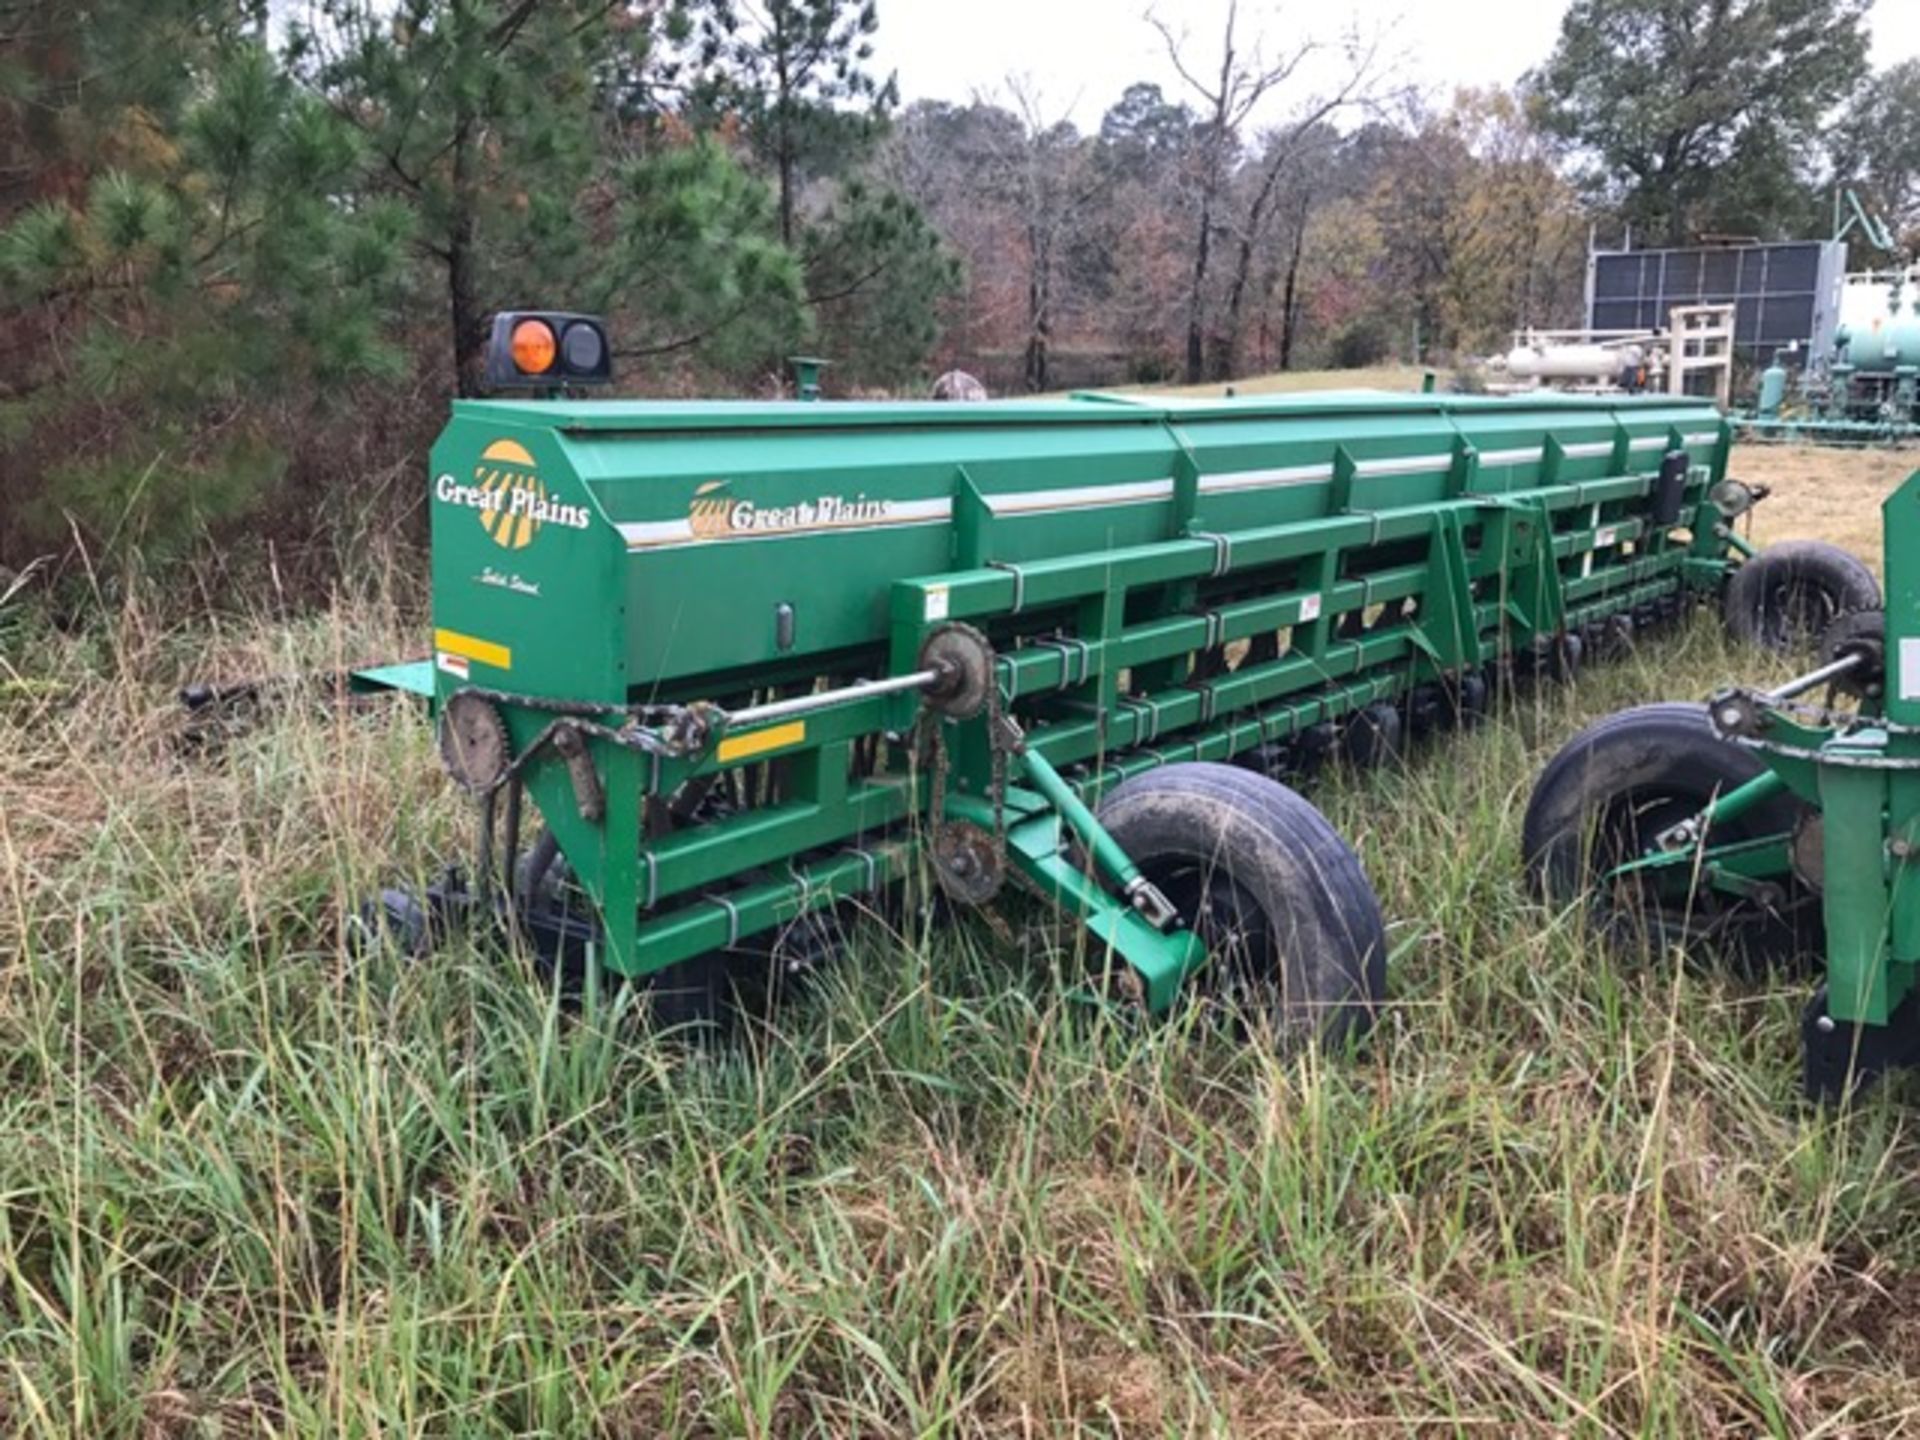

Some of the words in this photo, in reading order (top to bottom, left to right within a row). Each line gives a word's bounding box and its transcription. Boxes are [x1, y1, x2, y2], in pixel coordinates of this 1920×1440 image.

[436, 474, 502, 511] Great
[510, 487, 591, 529] Plains
[731, 500, 809, 529] Great
[816, 493, 891, 523] Plains
